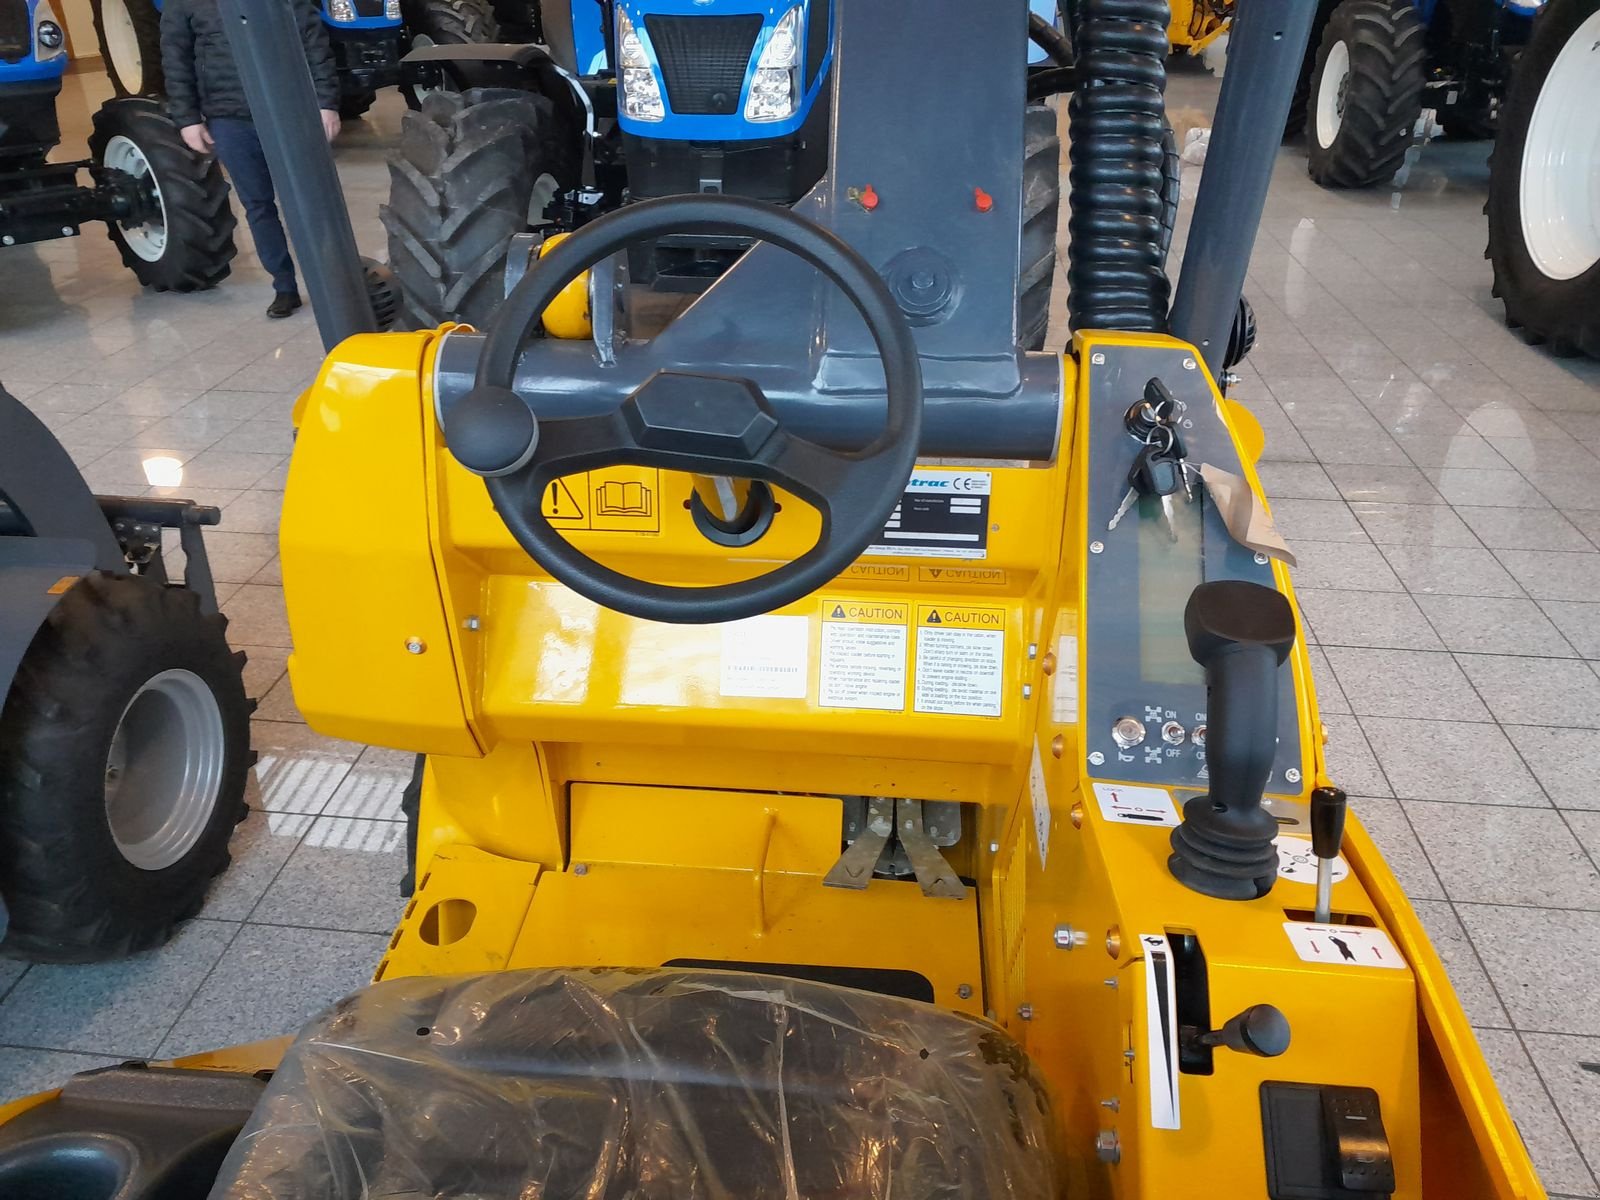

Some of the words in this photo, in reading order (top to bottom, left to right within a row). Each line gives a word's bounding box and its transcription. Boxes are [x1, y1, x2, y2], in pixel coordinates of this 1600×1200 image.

[953, 477, 972, 490] CE
[849, 607, 903, 620] CAUTION
[944, 611, 1000, 624] CAUTION
[1165, 710, 1177, 719] ON
[1195, 712, 1207, 721] ON
[1166, 748, 1182, 758] OFF
